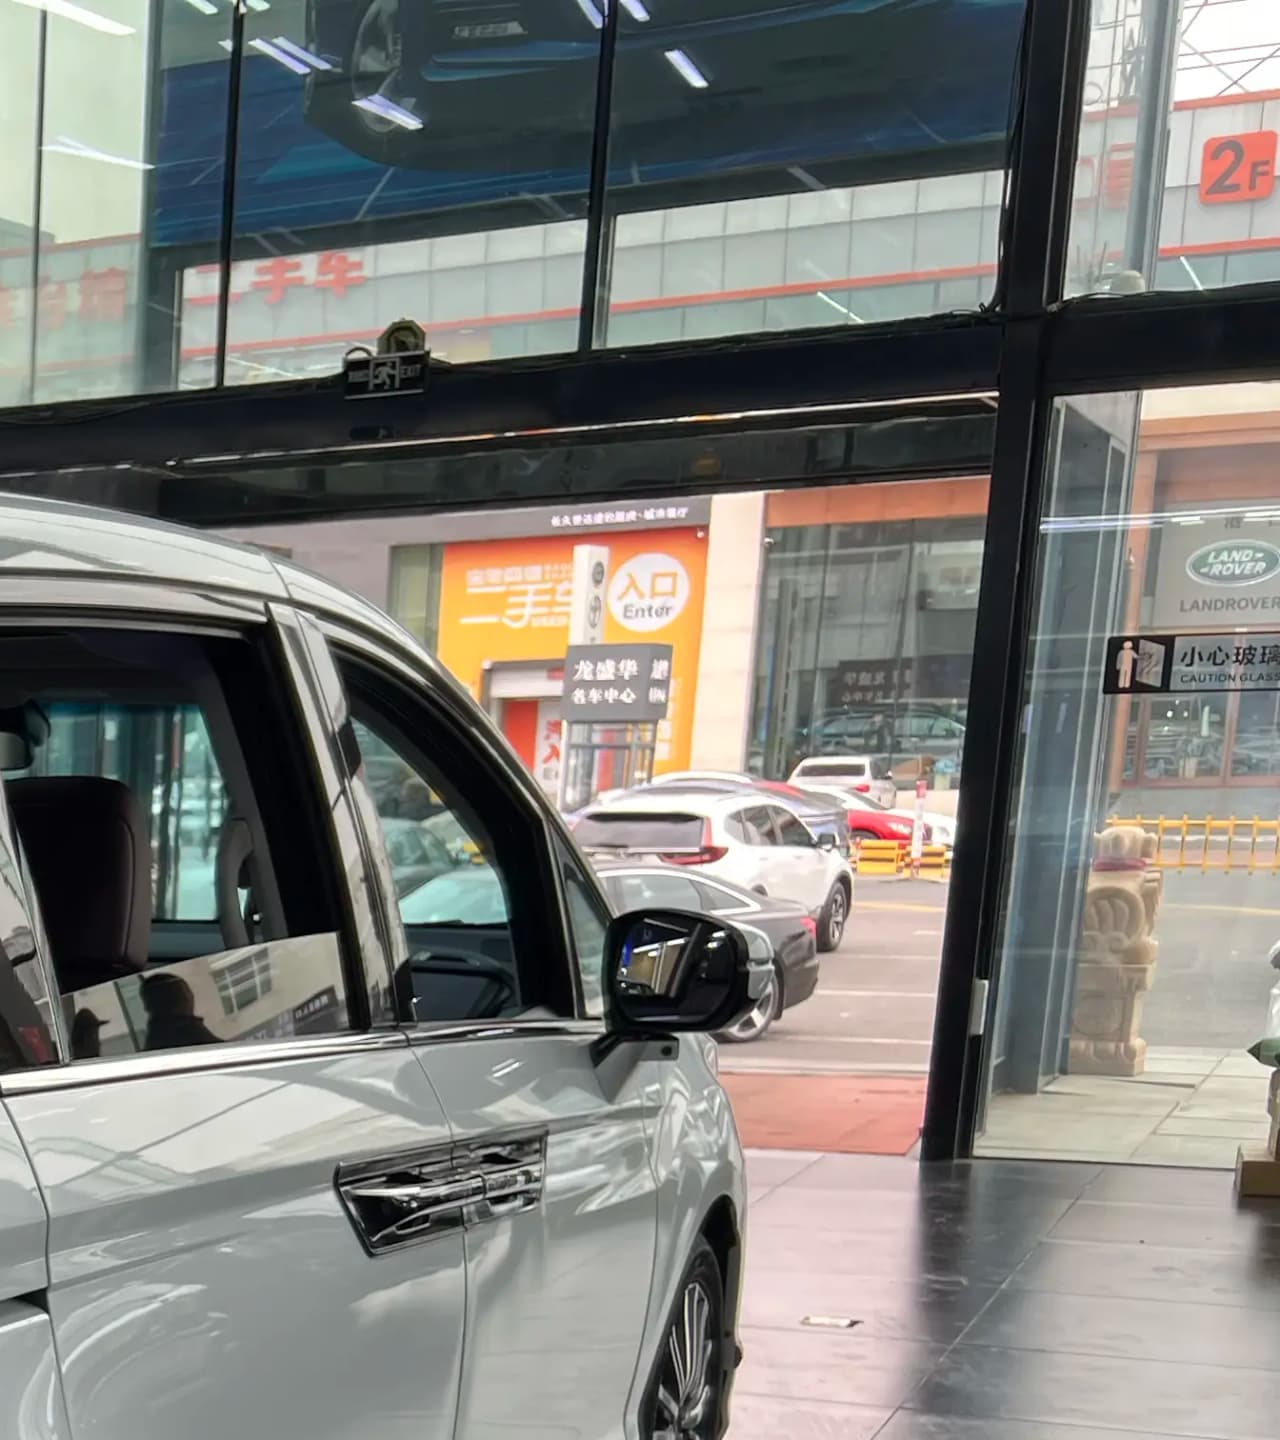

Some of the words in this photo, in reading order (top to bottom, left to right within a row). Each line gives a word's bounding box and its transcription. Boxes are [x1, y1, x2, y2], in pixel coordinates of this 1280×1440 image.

[618, 572, 679, 601] 入口
[622, 602, 673, 620] Enter
[1180, 644, 1280, 668] 小心玻璃
[1180, 673, 1236, 684] CAUTION
